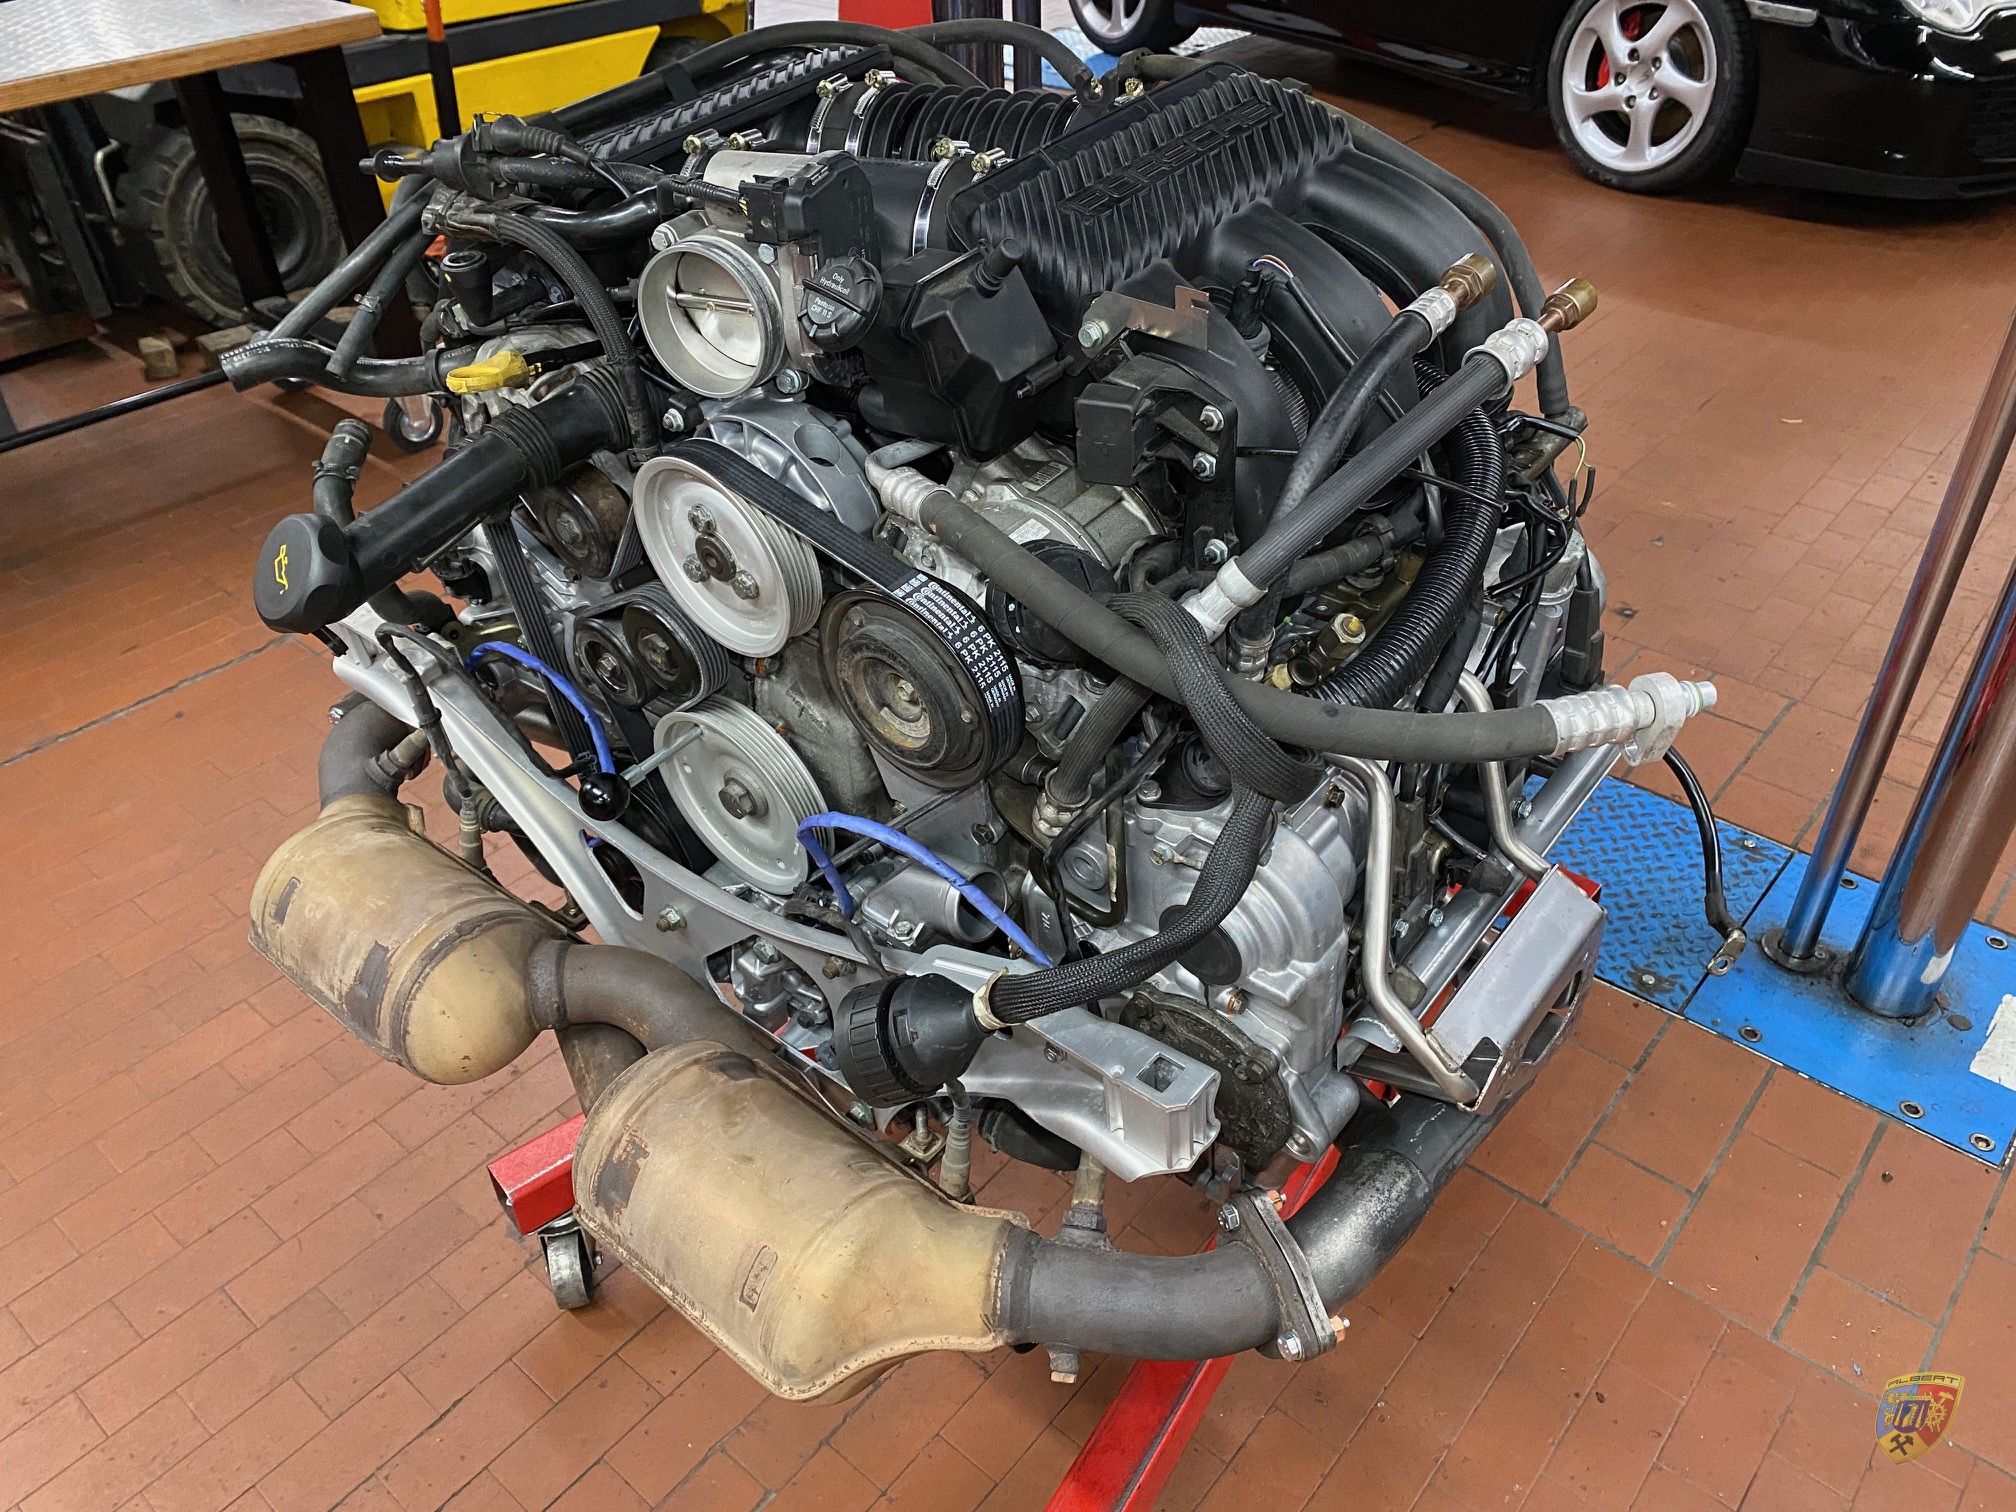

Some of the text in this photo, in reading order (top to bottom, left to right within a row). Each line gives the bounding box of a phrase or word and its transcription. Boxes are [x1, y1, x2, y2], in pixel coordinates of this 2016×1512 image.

[832, 272, 844, 284] Only
[904, 597, 950, 636] Continental
[954, 641, 963, 650] 6
[960, 649, 974, 665] PK
[970, 667, 987, 690] 2115
[912, 592, 957, 632] Continental
[962, 636, 971, 644] 6
[968, 643, 981, 660] PK
[978, 660, 994, 684] 2115
[920, 586, 964, 628] Continental
[969, 630, 978, 638] 6
[975, 638, 989, 654] PK
[985, 654, 1002, 678] 2115
[928, 581, 1009, 672] Continental 6 PK 2115
